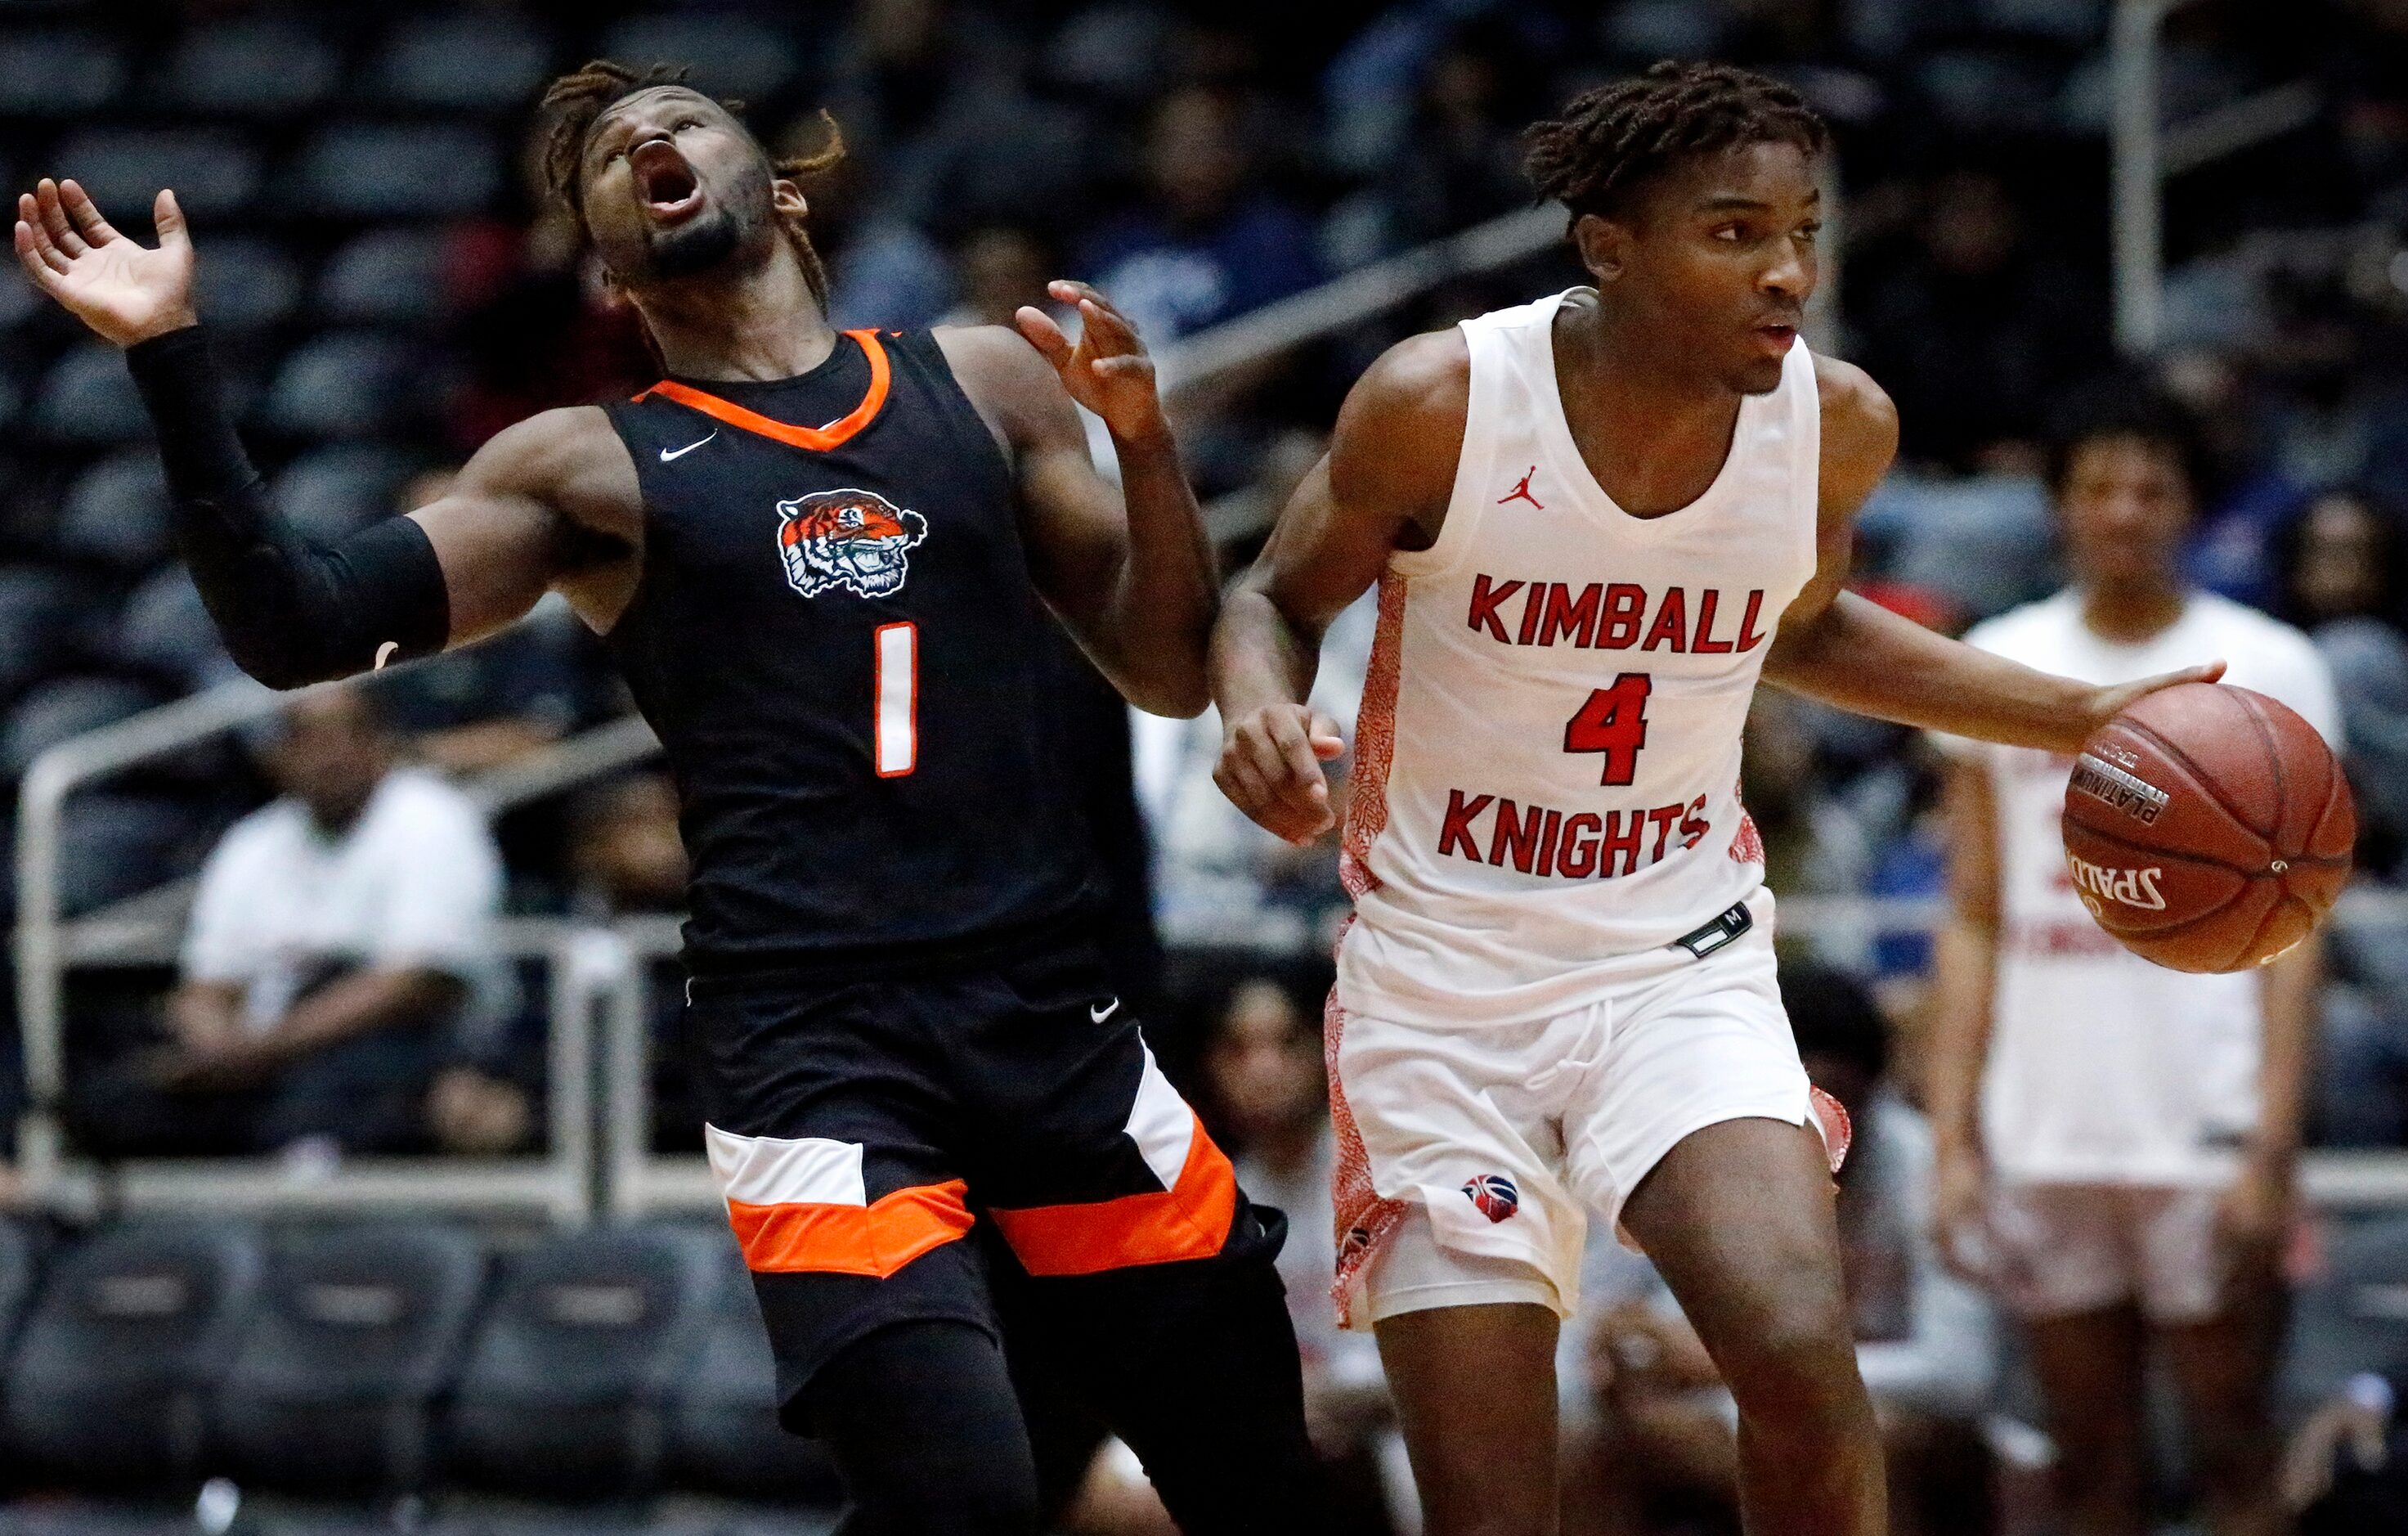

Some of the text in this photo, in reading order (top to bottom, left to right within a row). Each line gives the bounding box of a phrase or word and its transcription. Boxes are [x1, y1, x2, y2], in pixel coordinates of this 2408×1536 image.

[1468, 573, 1766, 654] KIMBALL
[874, 621, 918, 778] 1
[1563, 671, 1652, 787] 4
[1437, 788, 1711, 878] KNIGHTS
[1724, 909, 1742, 926] M
[2067, 850, 2166, 910] SPALD
